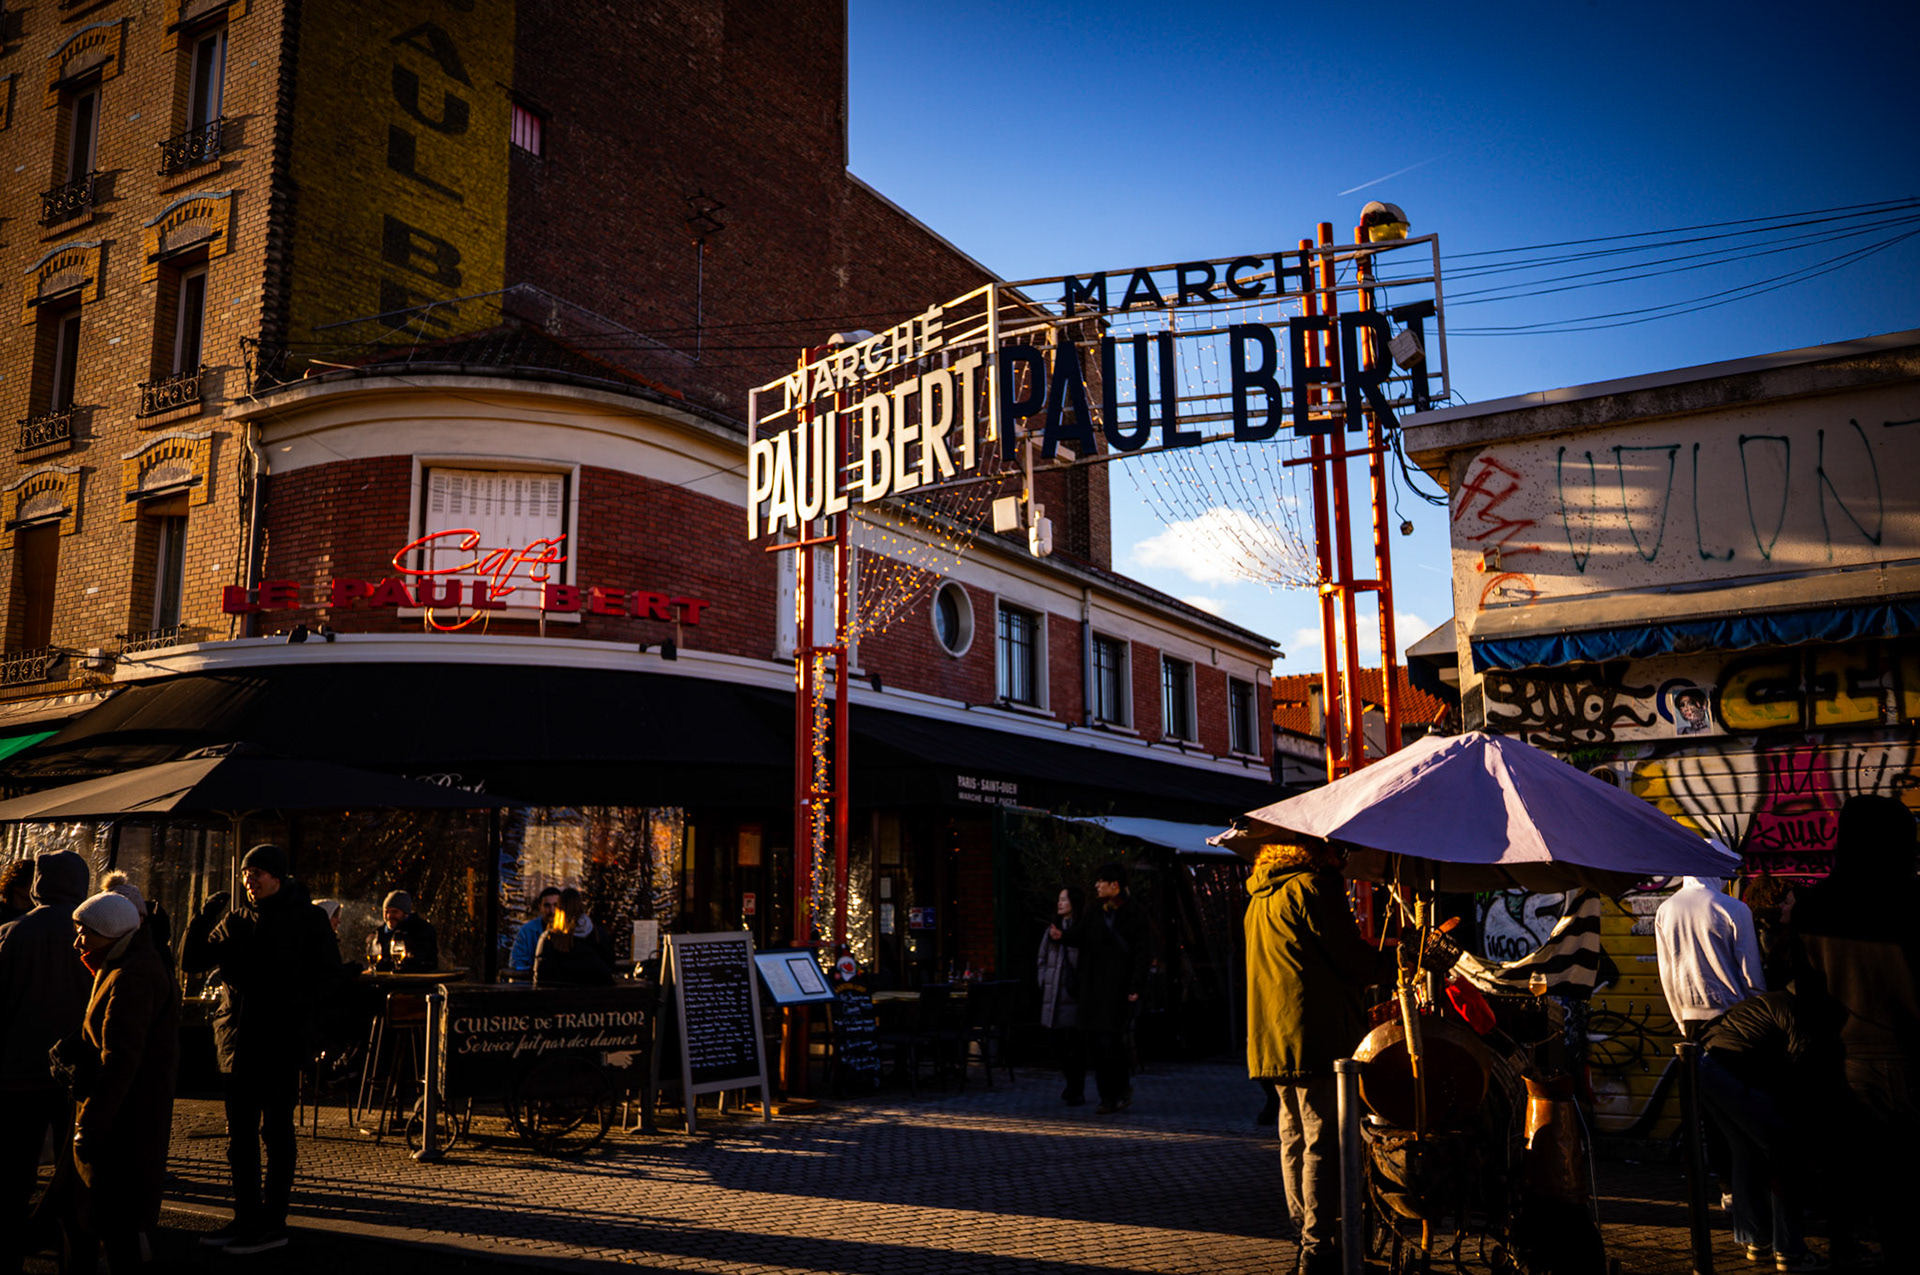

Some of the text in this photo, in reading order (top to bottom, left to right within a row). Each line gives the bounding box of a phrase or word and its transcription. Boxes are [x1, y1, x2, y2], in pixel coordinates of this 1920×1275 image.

[388, 0, 475, 204] AUL
[1064, 249, 1312, 316] MARCH
[784, 303, 944, 411] MARCHÉ
[1000, 300, 1437, 461] PAUL BERT
[748, 351, 983, 541] PAUL BERT
[392, 528, 567, 601] Café
[222, 577, 710, 626] LE PAUL BERT
[453, 1015, 530, 1034] CUISINE
[554, 1009, 645, 1029] TRADITION
[458, 1029, 639, 1060] Service fait par des dames
